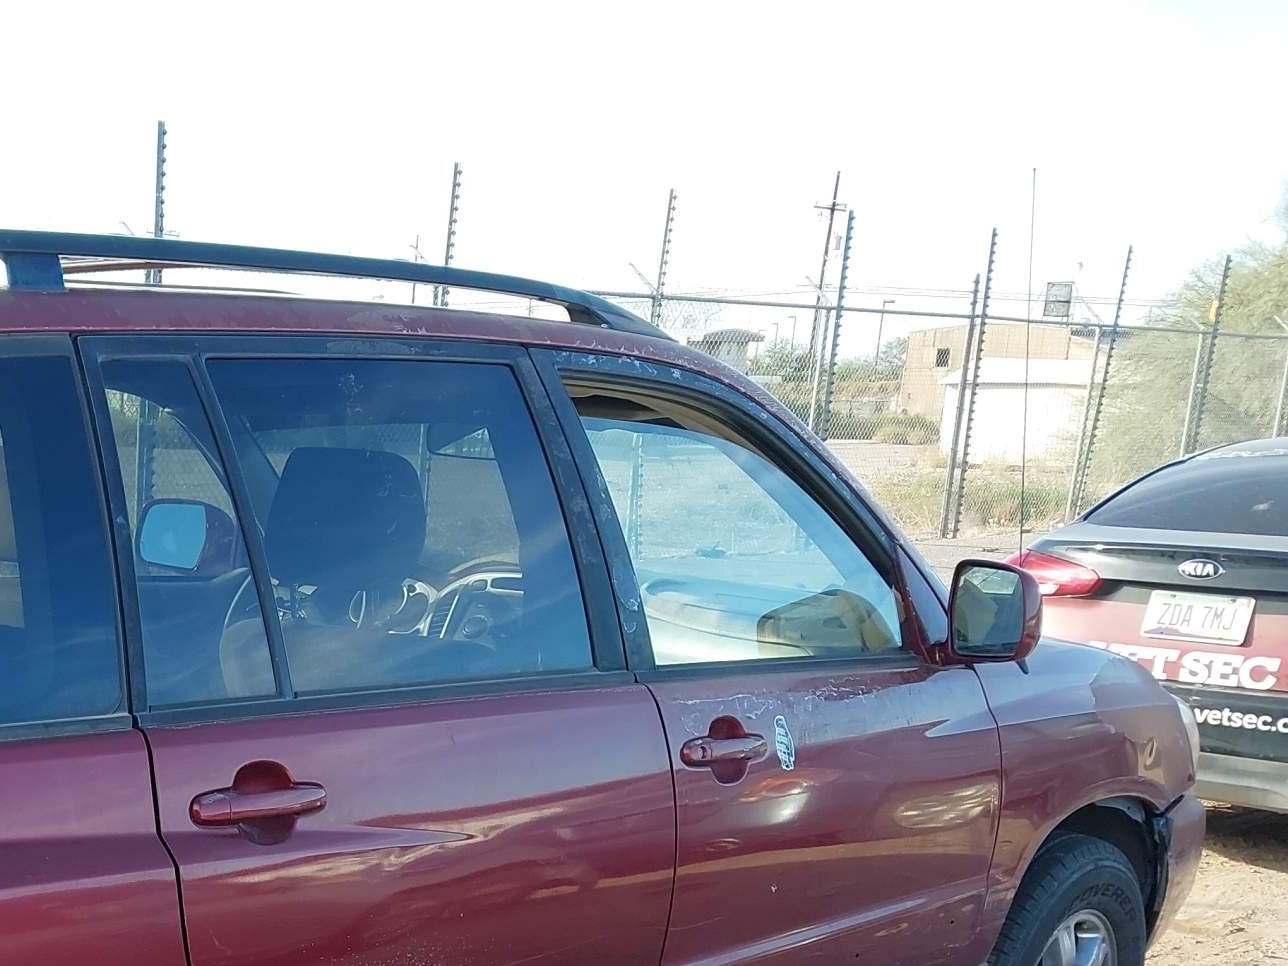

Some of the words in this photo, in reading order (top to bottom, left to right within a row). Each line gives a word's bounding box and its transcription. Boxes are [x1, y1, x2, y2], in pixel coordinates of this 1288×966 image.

[1182, 562, 1215, 577] KIA
[1157, 602, 1193, 626] ZDA
[1202, 606, 1238, 631] 7MJ
[1179, 650, 1281, 690] SEC
